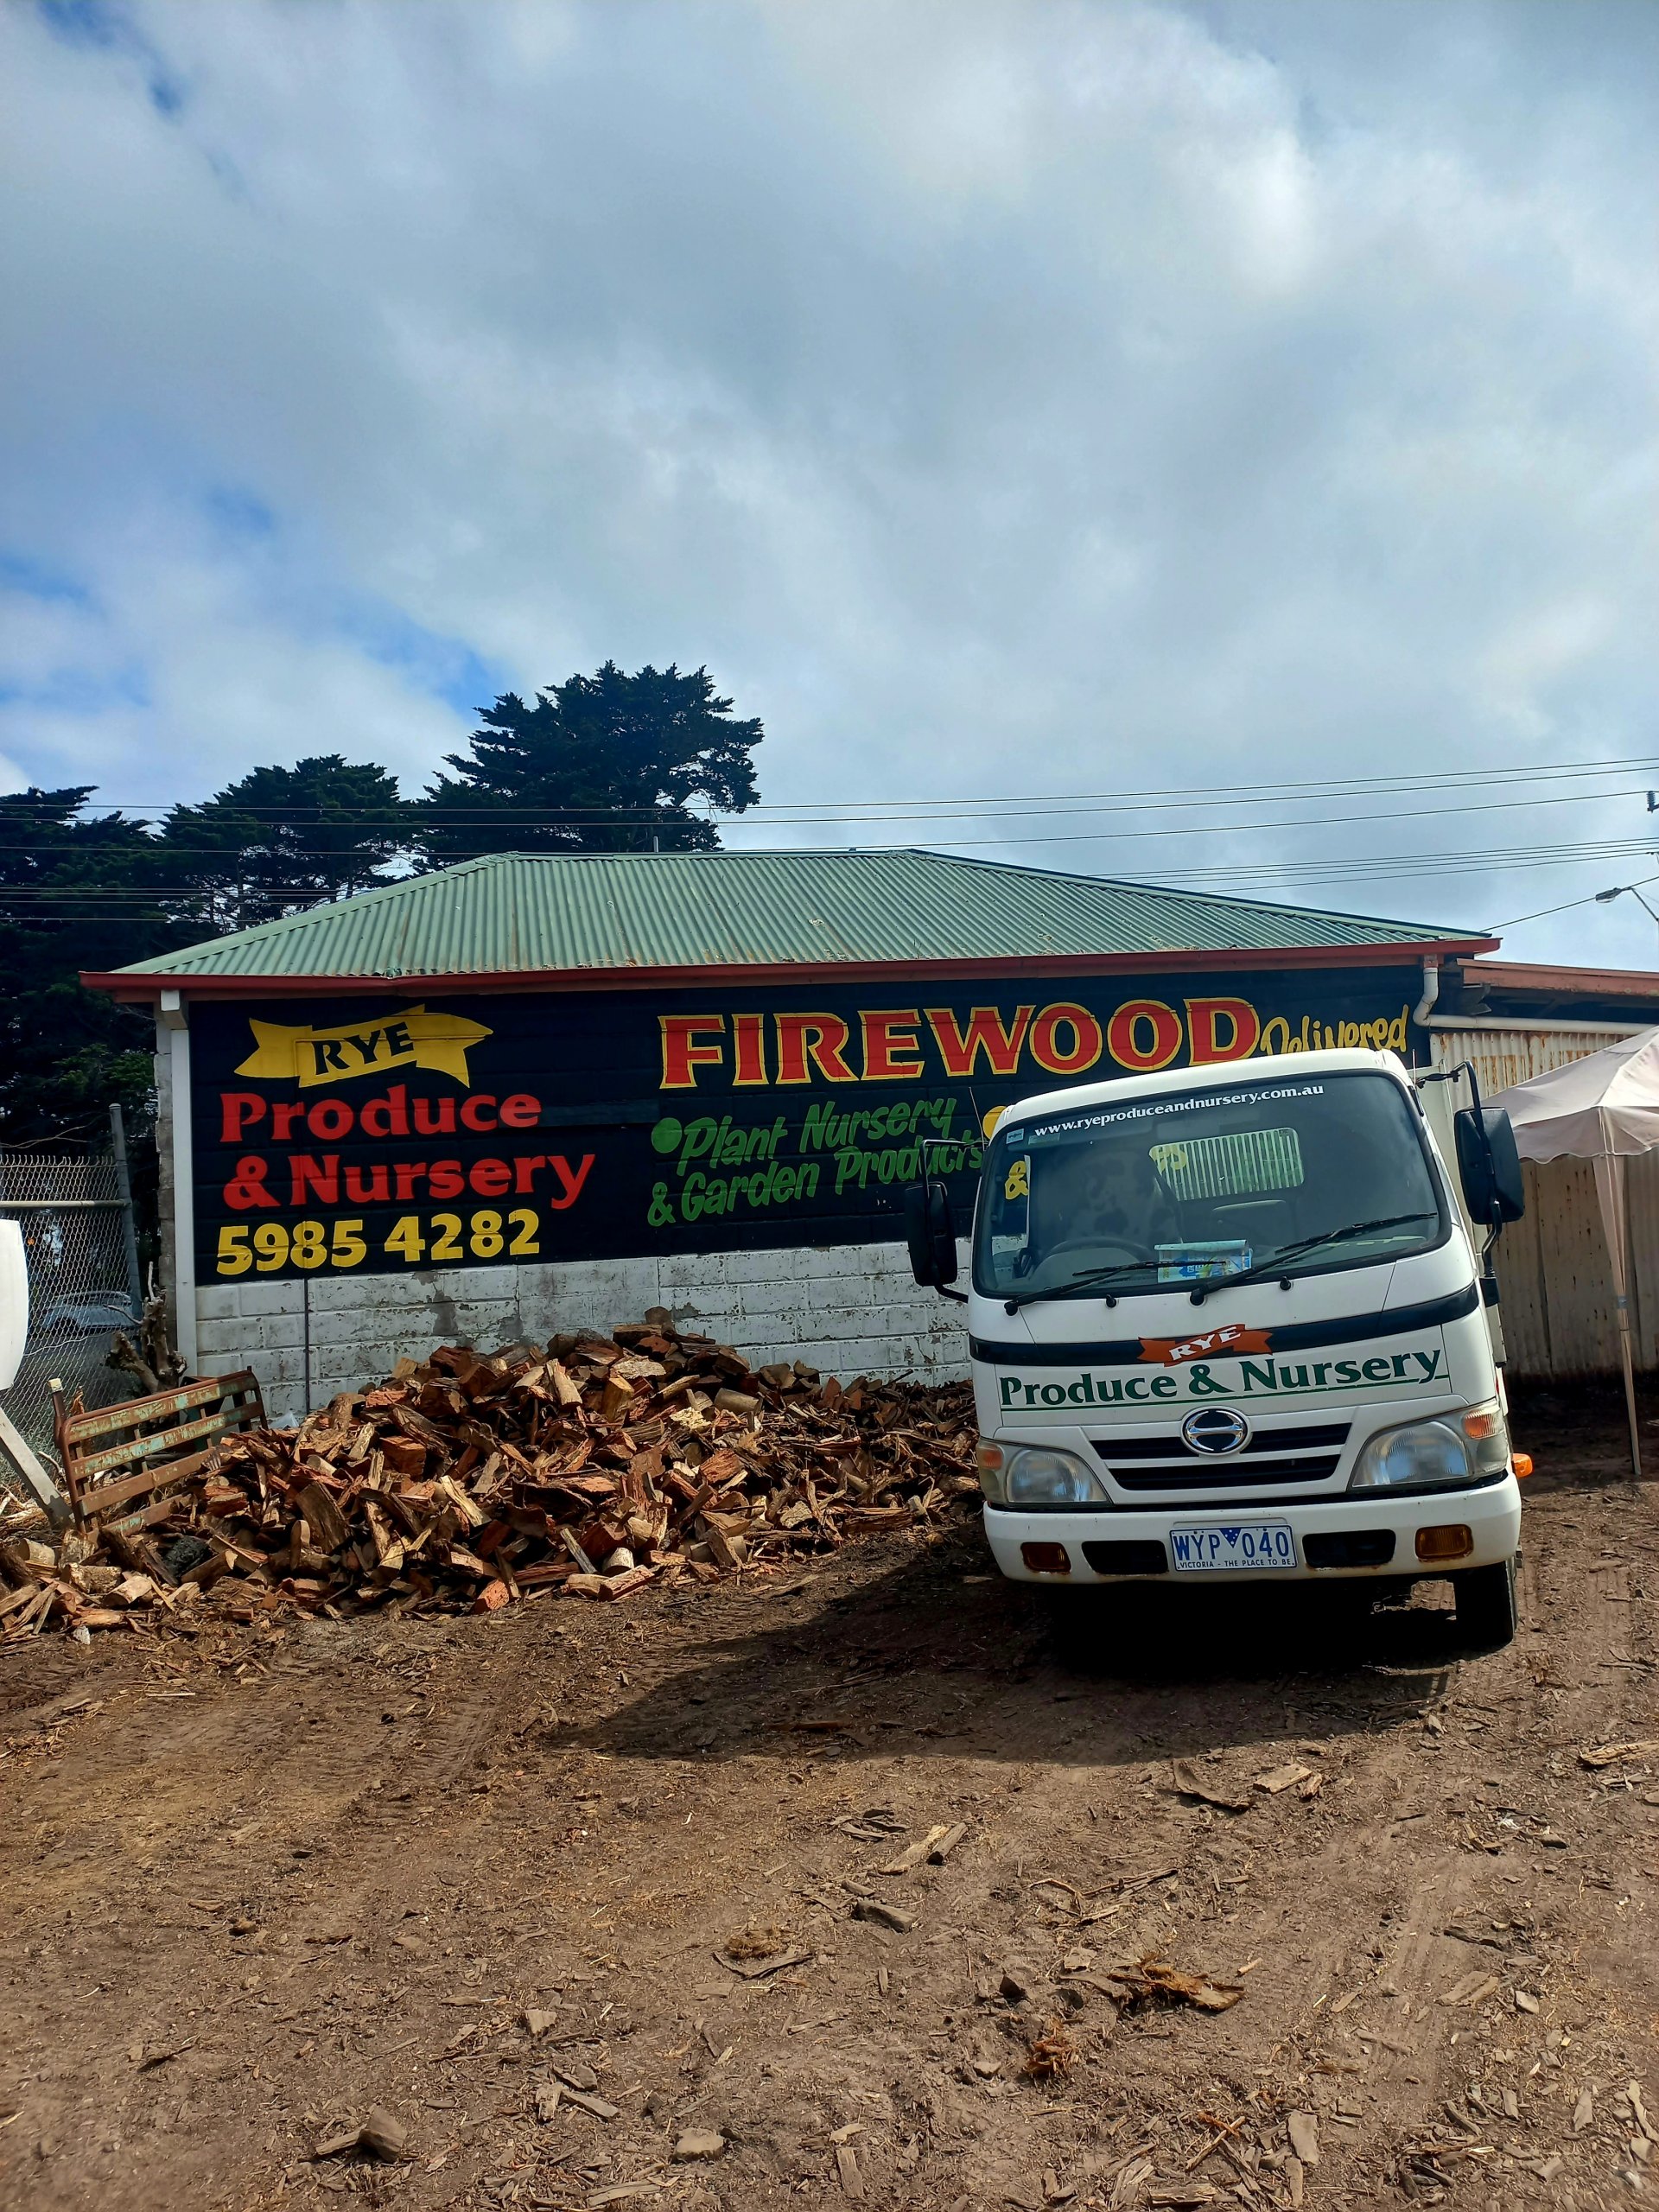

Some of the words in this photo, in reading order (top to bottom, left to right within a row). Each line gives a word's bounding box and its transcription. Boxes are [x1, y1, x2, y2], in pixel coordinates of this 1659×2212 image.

[312, 1021, 415, 1076] RYE
[657, 996, 1261, 1090] FIREWOOD
[219, 1084, 542, 1142] Produce
[677, 1116, 787, 1176] Plant
[799, 1098, 957, 1153] Nursery
[1034, 1084, 1324, 1136] www.ryeproduceandnursery.com.au
[222, 1155, 281, 1210] &
[288, 1154, 596, 1210] Nursery
[647, 1181, 677, 1227] &
[681, 1162, 820, 1221] Garden
[216, 1219, 367, 1275] 5985
[384, 1209, 540, 1262] 4282
[1168, 1325, 1242, 1362] RYE
[1000, 1373, 1177, 1407] Produce
[1188, 1363, 1231, 1395] &
[1241, 1349, 1441, 1392] Nursery
[1173, 1534, 1221, 1560] WYP
[1242, 1531, 1289, 1558] 040
